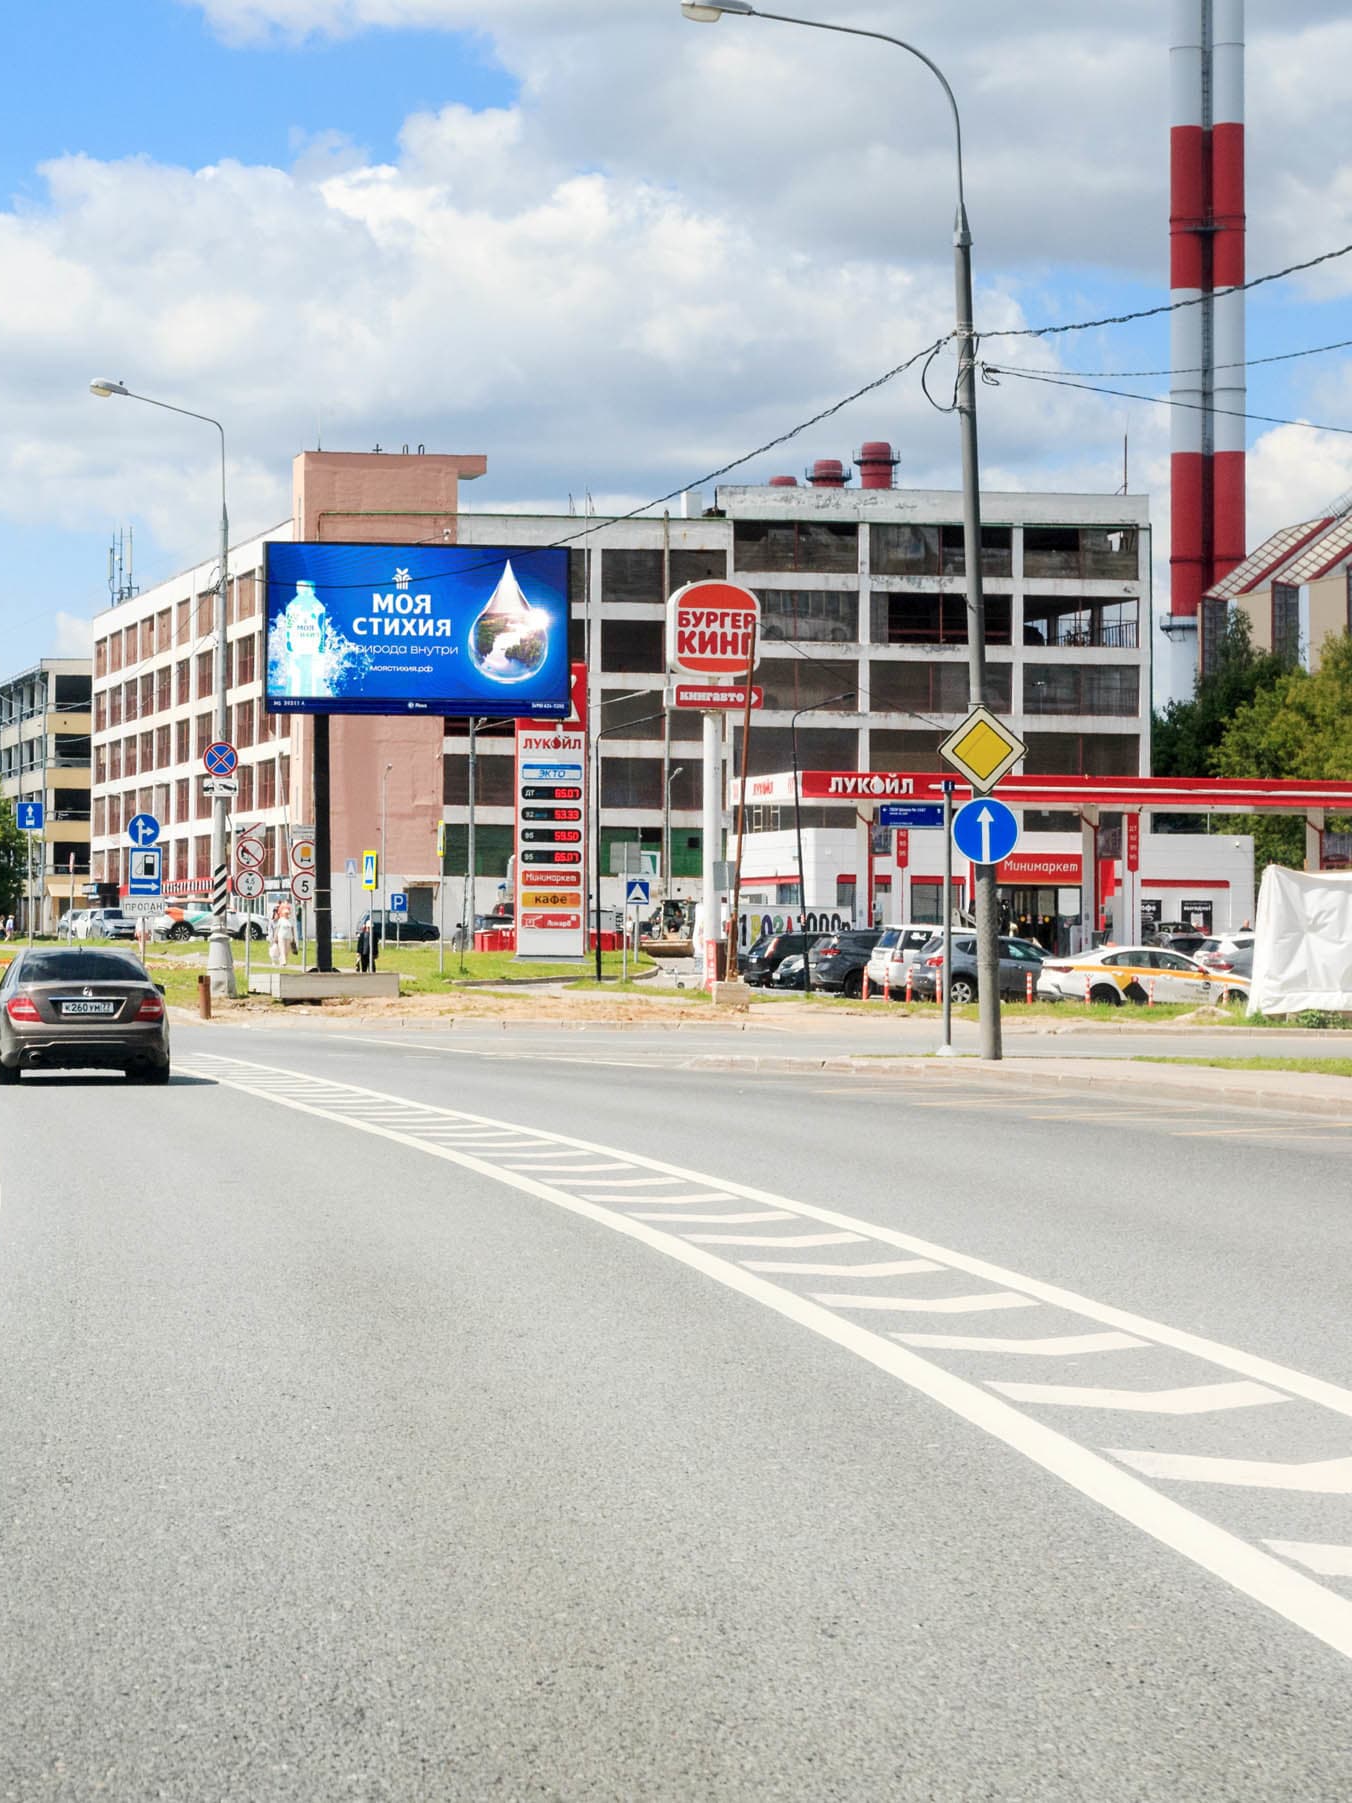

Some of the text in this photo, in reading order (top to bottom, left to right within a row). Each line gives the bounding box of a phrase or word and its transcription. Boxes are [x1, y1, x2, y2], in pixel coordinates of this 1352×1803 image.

[372, 593, 431, 614] МОЯ
[352, 617, 451, 637] СТИХИЯ
[678, 611, 756, 629] БУРГЕР
[351, 644, 459, 656] рирода внутри
[677, 630, 753, 656] КИНГ
[523, 735, 581, 750] ЛУКОЙЛ
[538, 769, 566, 778] ЭКТО
[828, 773, 914, 794] ЛУКОЙЛ
[524, 789, 536, 797] ДТ
[1004, 860, 1078, 875] Минимаркет
[301, 880, 309, 893] 5
[124, 902, 163, 911] ПРОПАН
[394, 896, 404, 910] P
[534, 895, 567, 904] кафе
